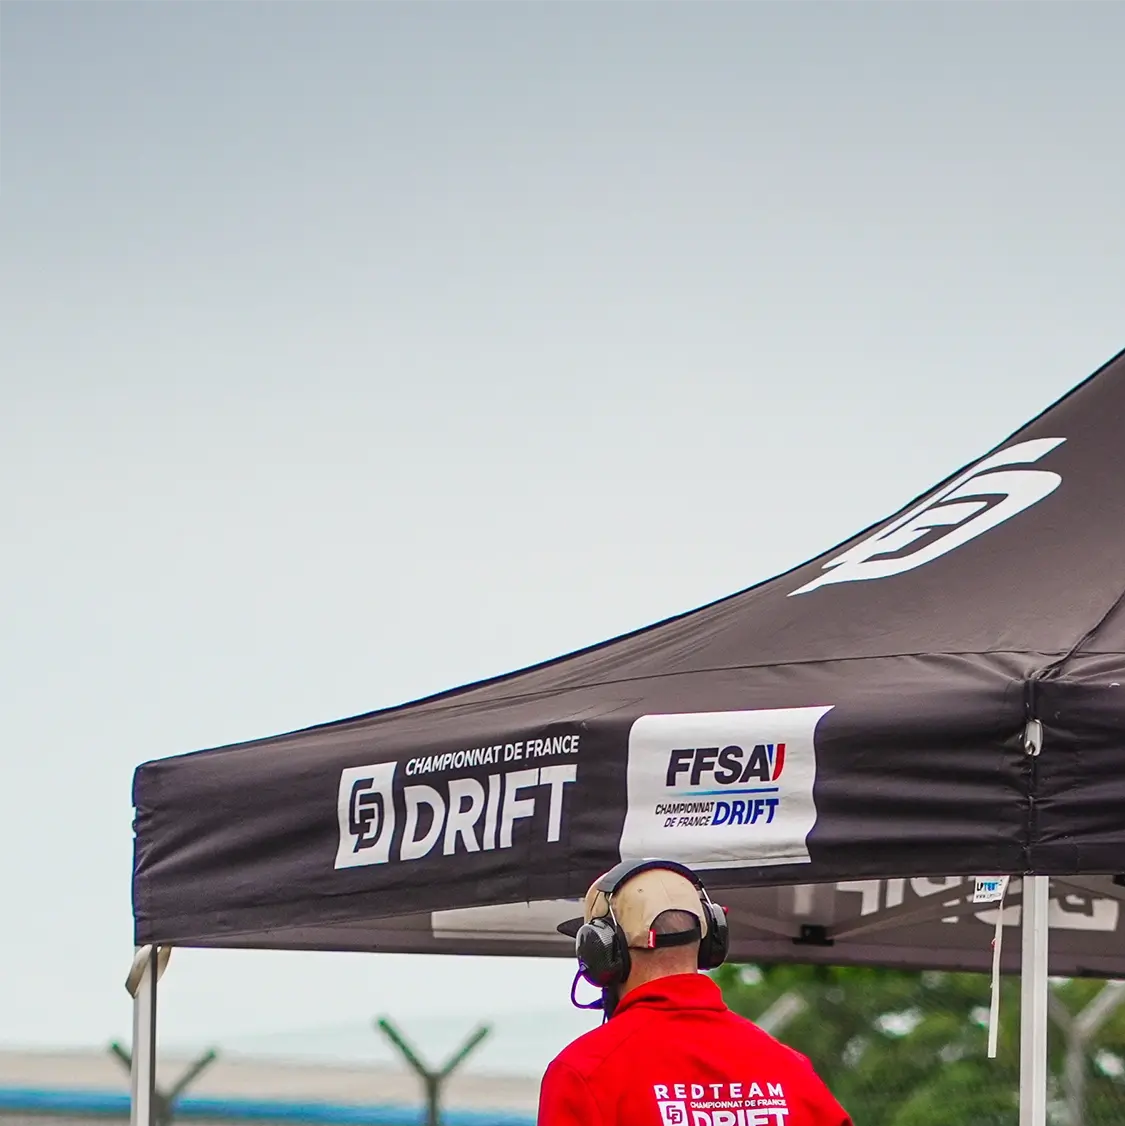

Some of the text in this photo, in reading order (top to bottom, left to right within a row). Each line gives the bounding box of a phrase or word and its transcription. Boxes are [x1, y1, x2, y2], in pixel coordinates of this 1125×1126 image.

[405, 735, 580, 776] CHAMPIONNAT DE FRANCE
[666, 743, 775, 787] FFSA
[400, 763, 578, 862] DRIFT
[655, 801, 715, 815] CHAMPIONNAT
[664, 815, 712, 828] DE FRANCE
[711, 798, 779, 826] DRIFT
[690, 1100, 744, 1109] CHAMPIONNAT
[757, 1098, 787, 1107] FRANCE
